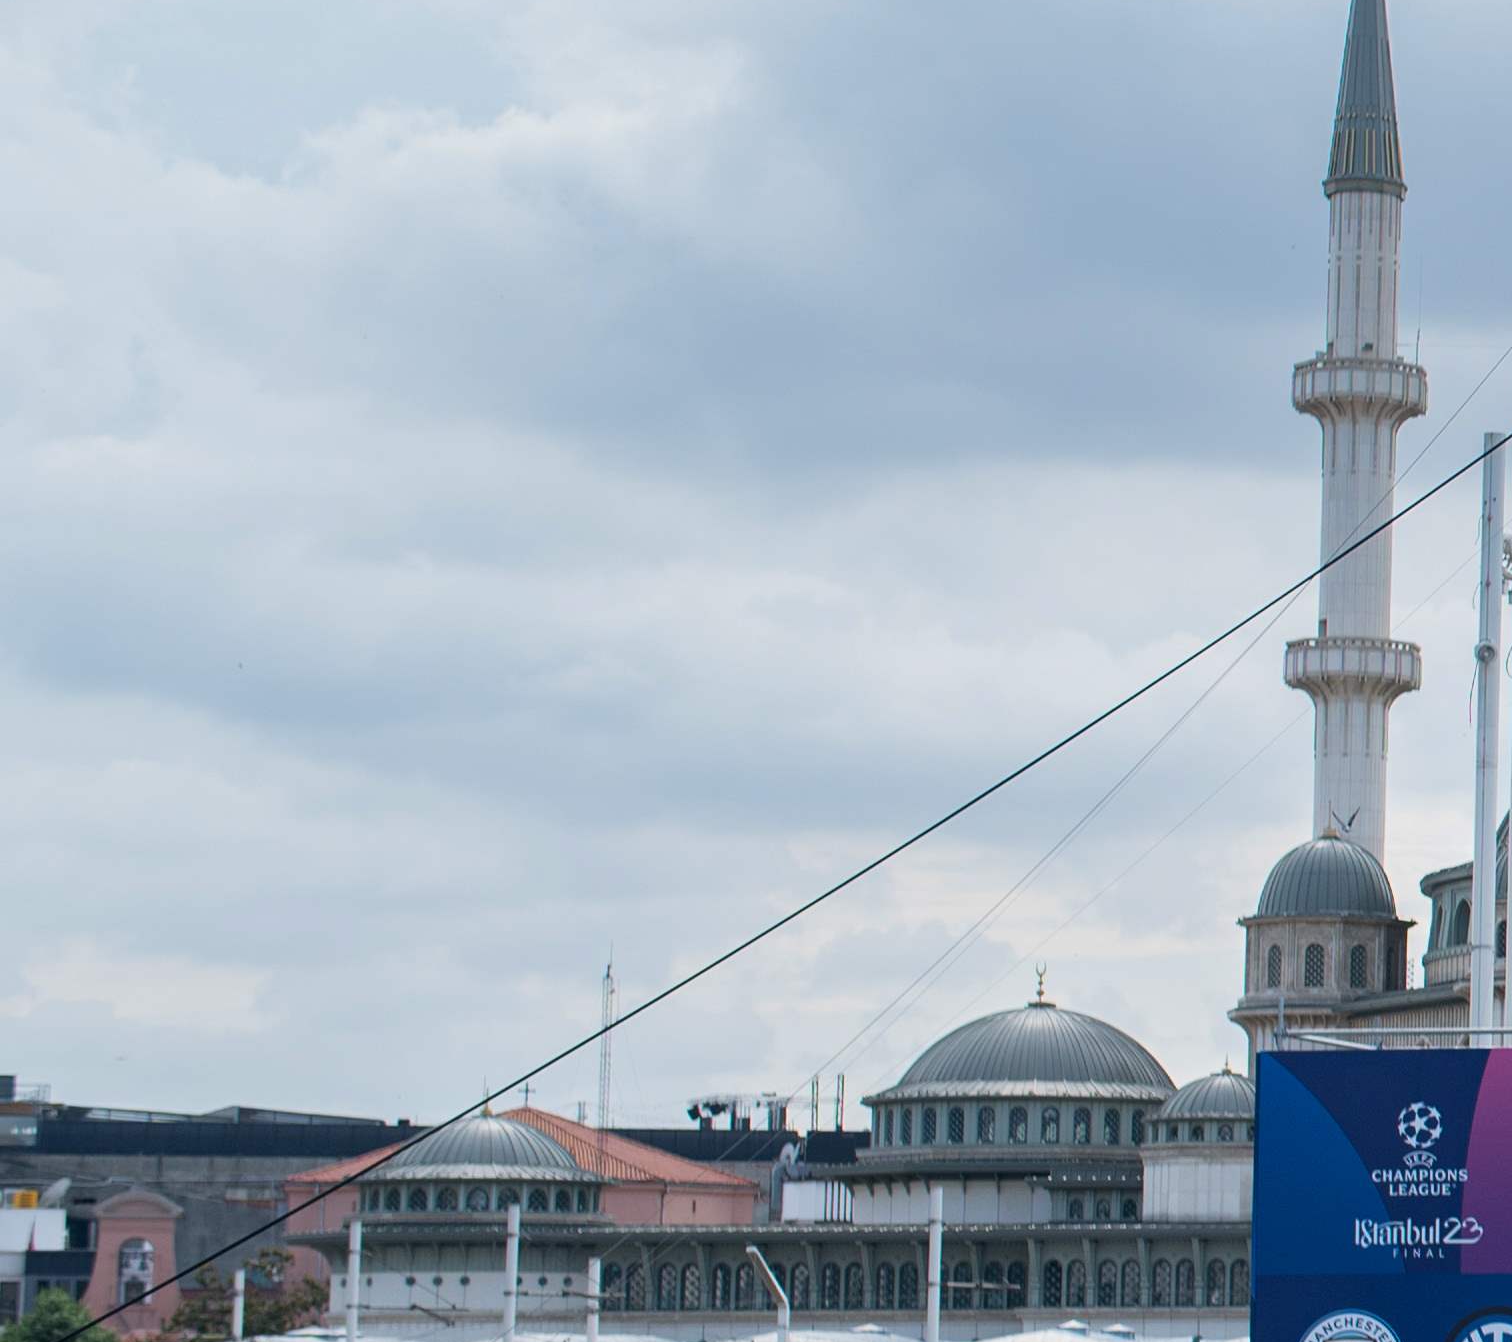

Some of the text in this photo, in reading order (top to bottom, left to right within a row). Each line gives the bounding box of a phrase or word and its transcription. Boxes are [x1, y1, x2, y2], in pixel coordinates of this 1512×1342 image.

[1372, 1169, 1468, 1183] CHAMPIONS
[1389, 1183, 1451, 1197] LEAGUE
[1442, 1216, 1484, 1245] 23
[1393, 1247, 1445, 1259] FINAL
